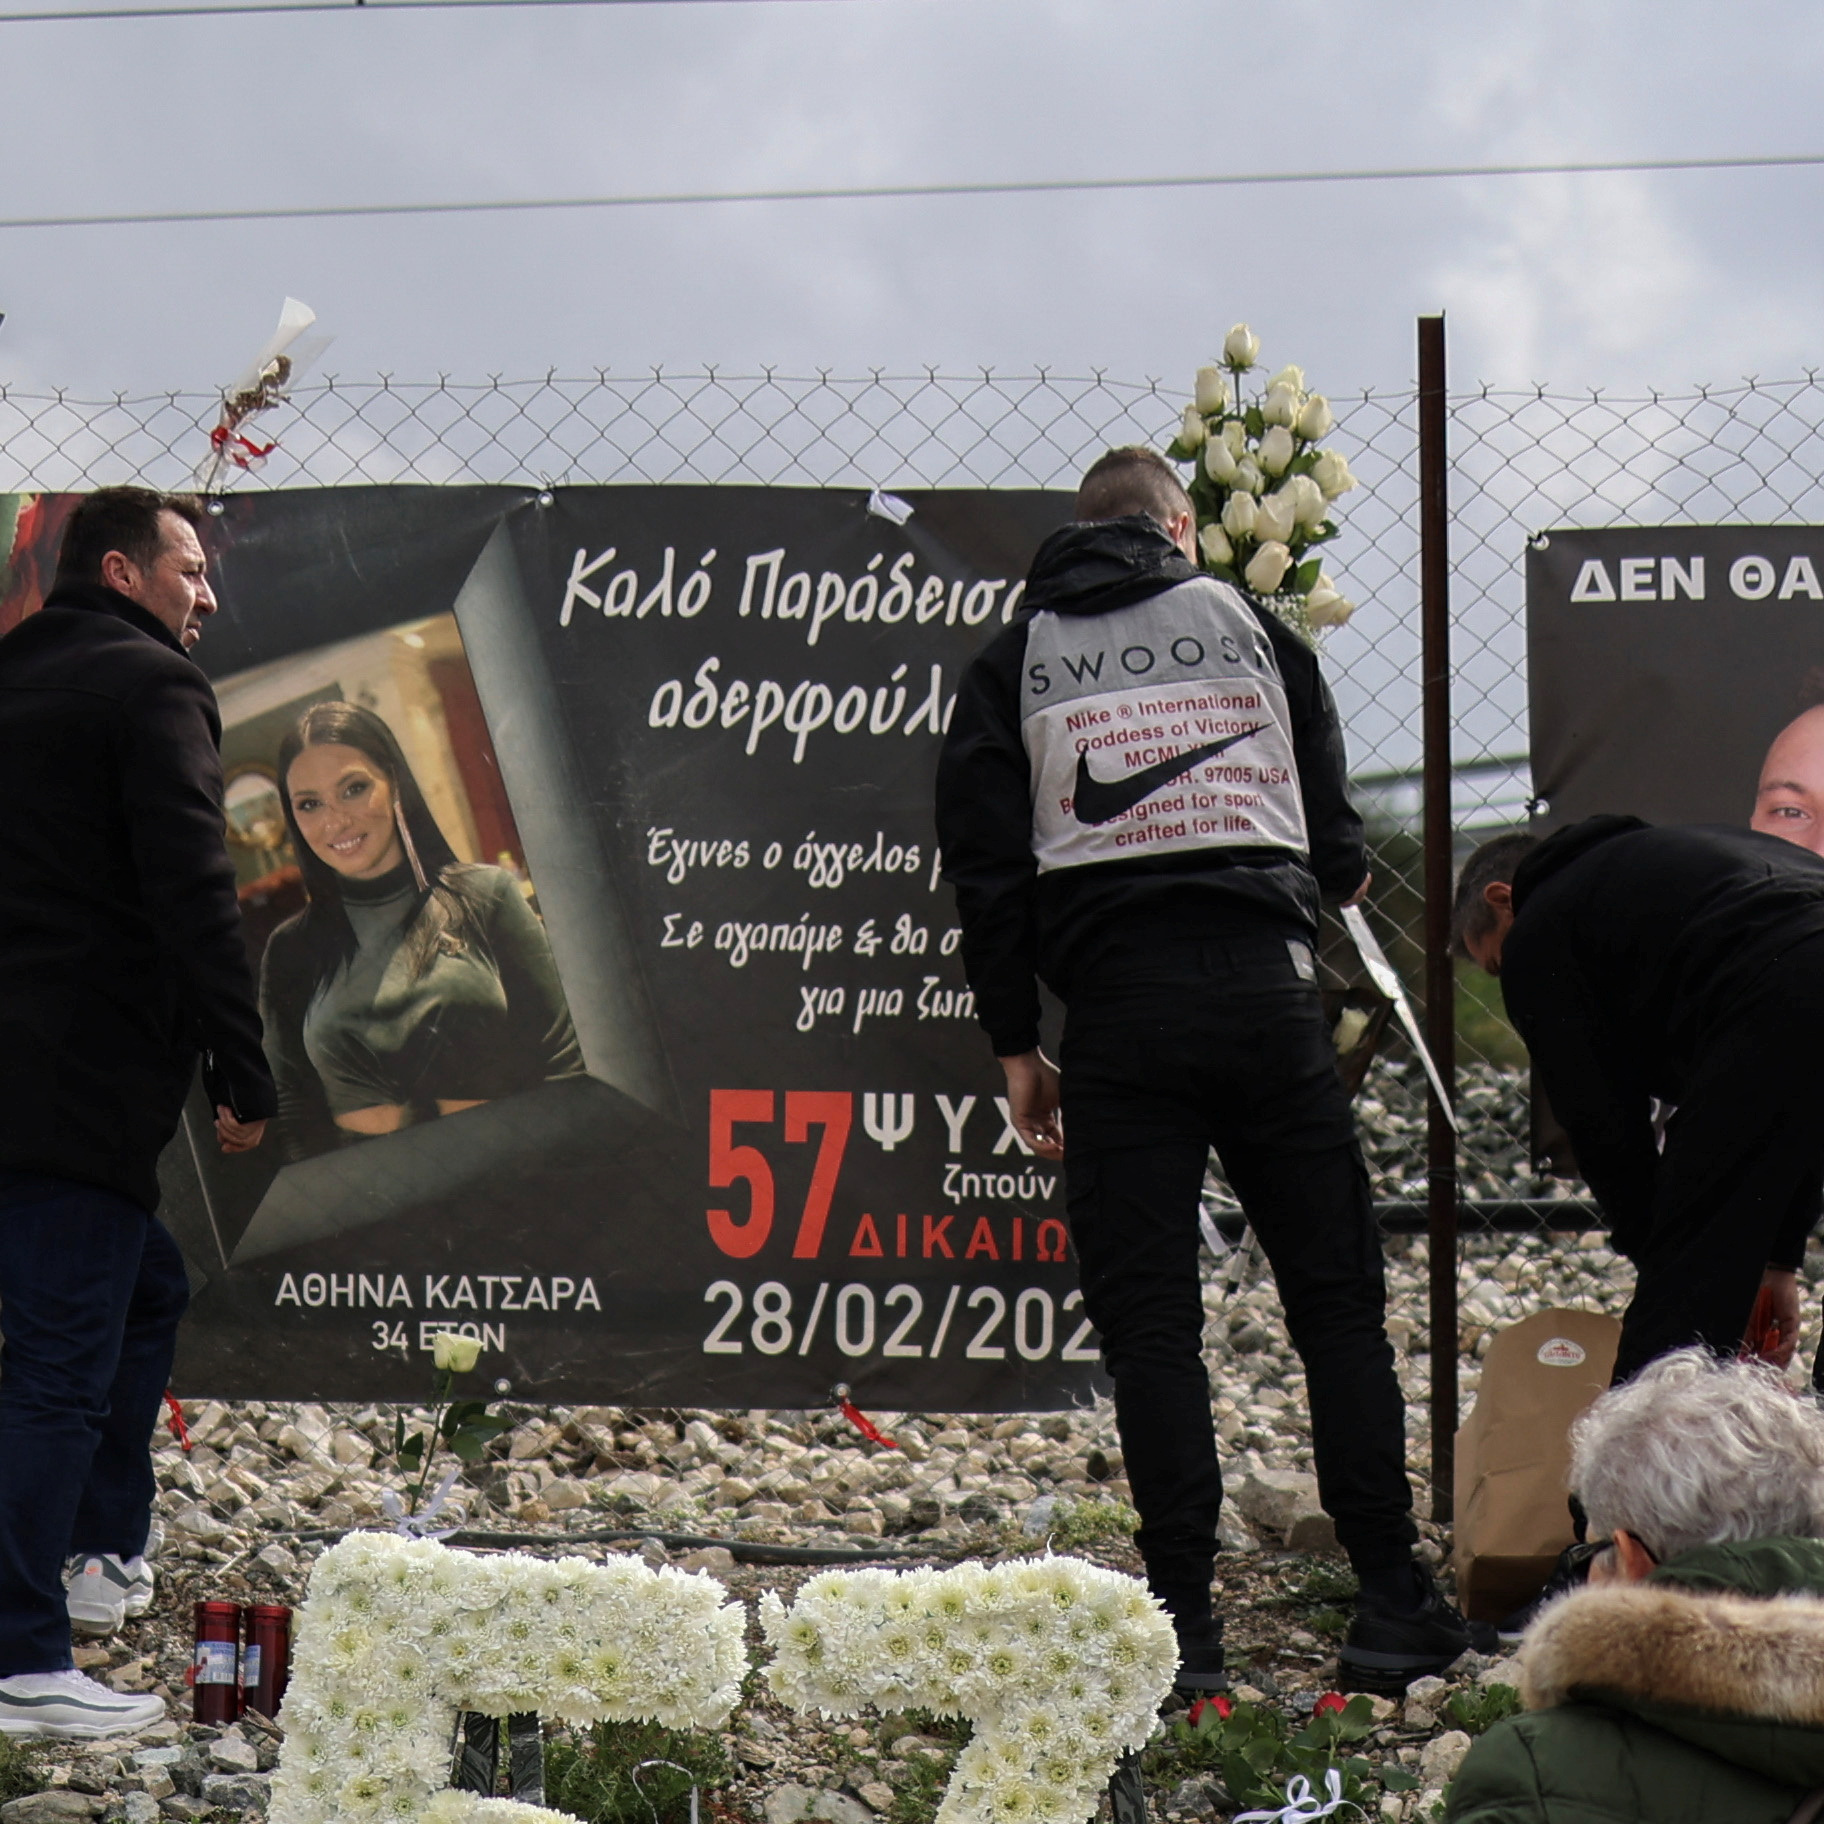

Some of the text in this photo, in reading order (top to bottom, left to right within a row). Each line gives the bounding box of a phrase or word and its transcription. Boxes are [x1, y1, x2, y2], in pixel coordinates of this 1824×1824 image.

[560, 546, 717, 626] Καλό
[1570, 555, 1705, 603] ΔΕΝ
[1729, 555, 1824, 601] ΘΑ
[1066, 708, 1111, 733] Nike
[1138, 693, 1261, 717] International
[1074, 718, 1260, 755] Goddess of Victory
[1204, 767, 1252, 784] 97005
[1259, 767, 1290, 784] USA
[1192, 794, 1217, 810] for
[1115, 815, 1256, 847] crafted for life.
[647, 827, 750, 884] Έγινες
[763, 841, 782, 869] ο
[793, 831, 920, 888] άγγελος
[660, 913, 703, 948] Σε
[714, 912, 842, 971] αγαπάμε
[853, 919, 882, 957] &
[890, 913, 928, 955] θα
[796, 986, 844, 1032] για
[853, 988, 903, 1034] μια
[863, 1092, 1063, 1156] ΨΥΧ
[705, 1089, 853, 1259] 57
[943, 1163, 1056, 1205] ζητούν
[274, 1272, 602, 1311] ΑΘΗΝΑ ΚΑΤΣΑΡΑ
[372, 1321, 409, 1351] 34
